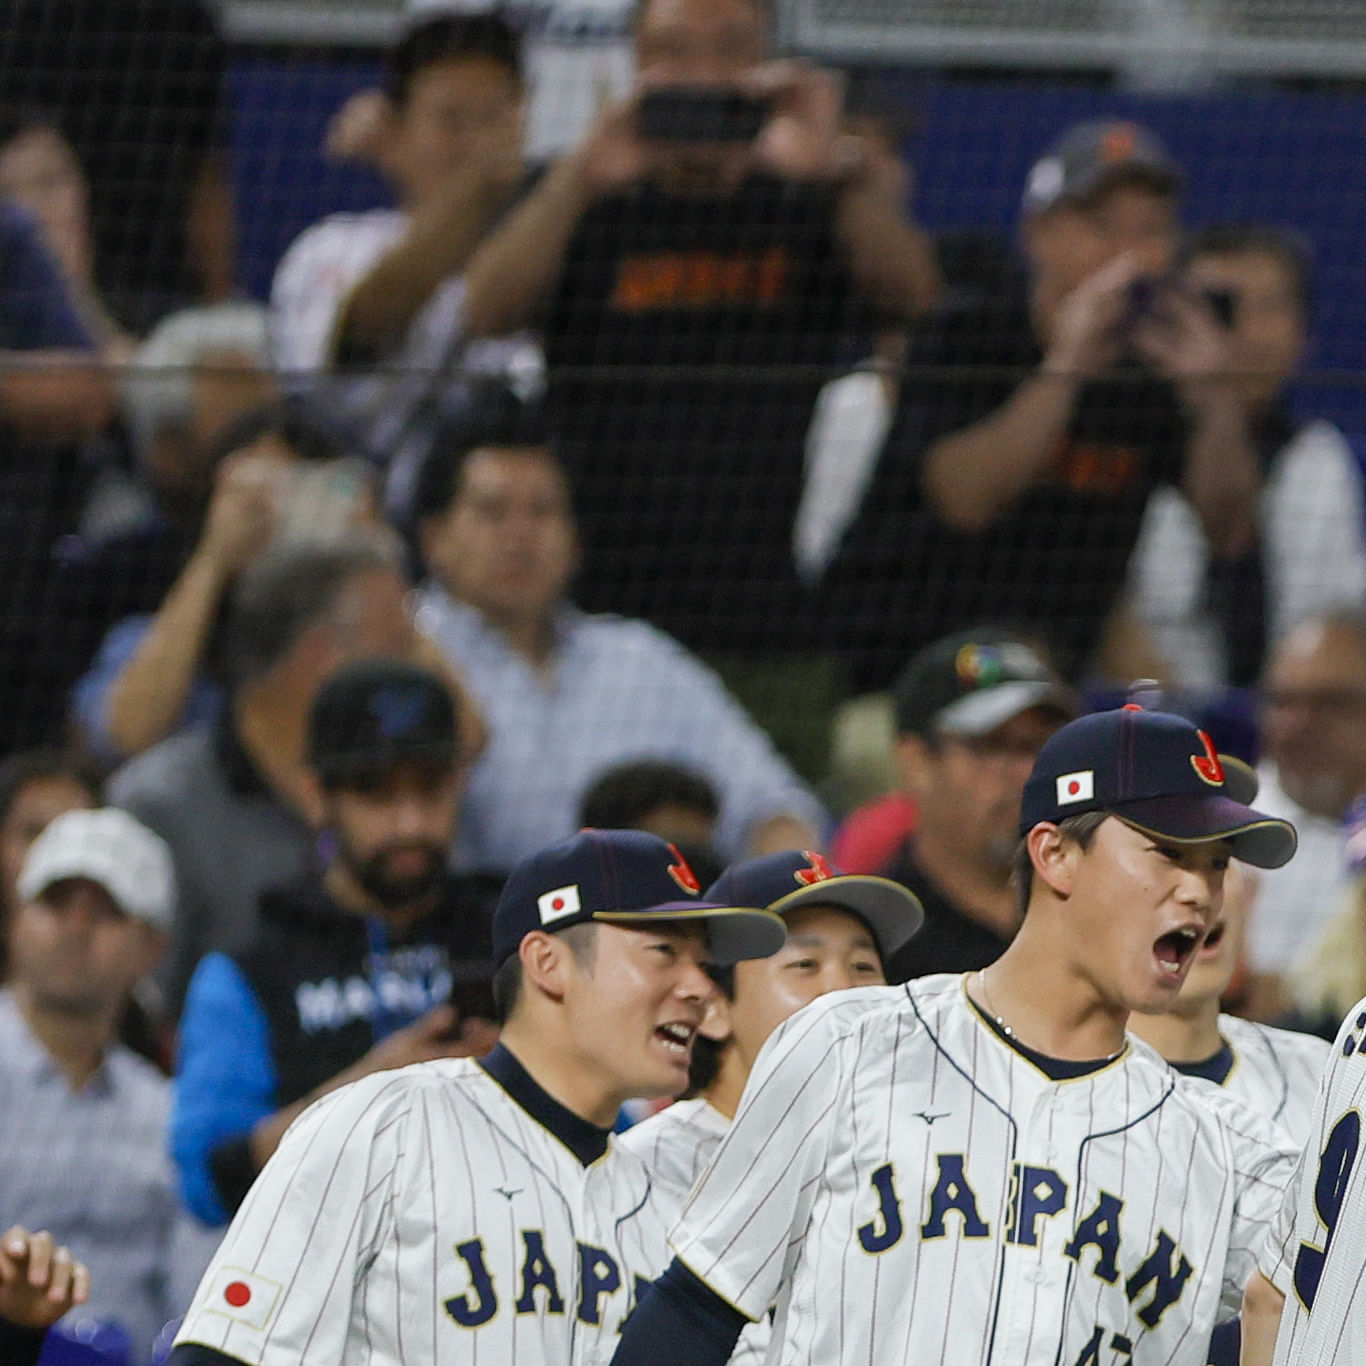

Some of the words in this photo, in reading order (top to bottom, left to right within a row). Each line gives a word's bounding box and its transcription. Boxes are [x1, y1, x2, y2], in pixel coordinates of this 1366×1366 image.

[1190, 728, 1224, 787] J
[444, 1228, 656, 1334] JAP
[857, 1153, 1194, 1330] JAPAN
